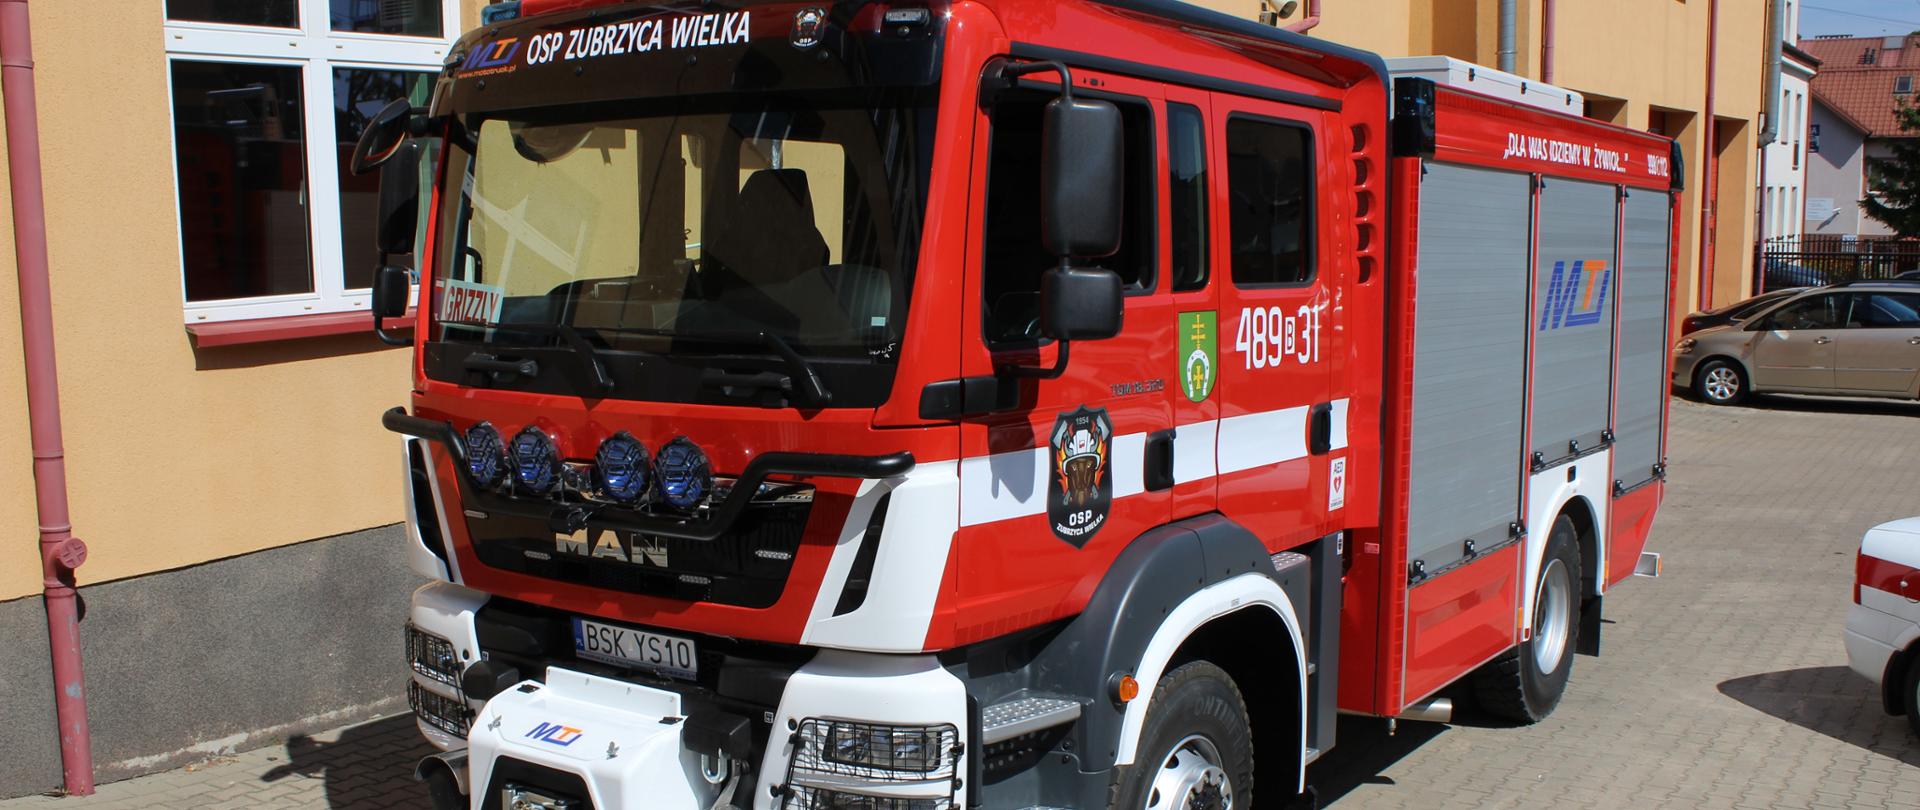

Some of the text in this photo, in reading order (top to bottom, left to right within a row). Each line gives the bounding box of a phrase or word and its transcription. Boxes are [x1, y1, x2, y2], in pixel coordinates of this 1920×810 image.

[526, 11, 750, 65] OSP ZUBRZYCA WIELKA
[1528, 136, 1548, 161] WAS
[1549, 140, 1581, 165] IDZIEMY
[1582, 145, 1591, 167] W
[444, 286, 499, 323] GRIZZLY
[1056, 513, 1104, 536] ZUBRZYCA WIELKA
[1068, 509, 1093, 527] OSP
[556, 527, 669, 568] MAN
[586, 623, 627, 658] BSK
[633, 632, 691, 669] YS10
